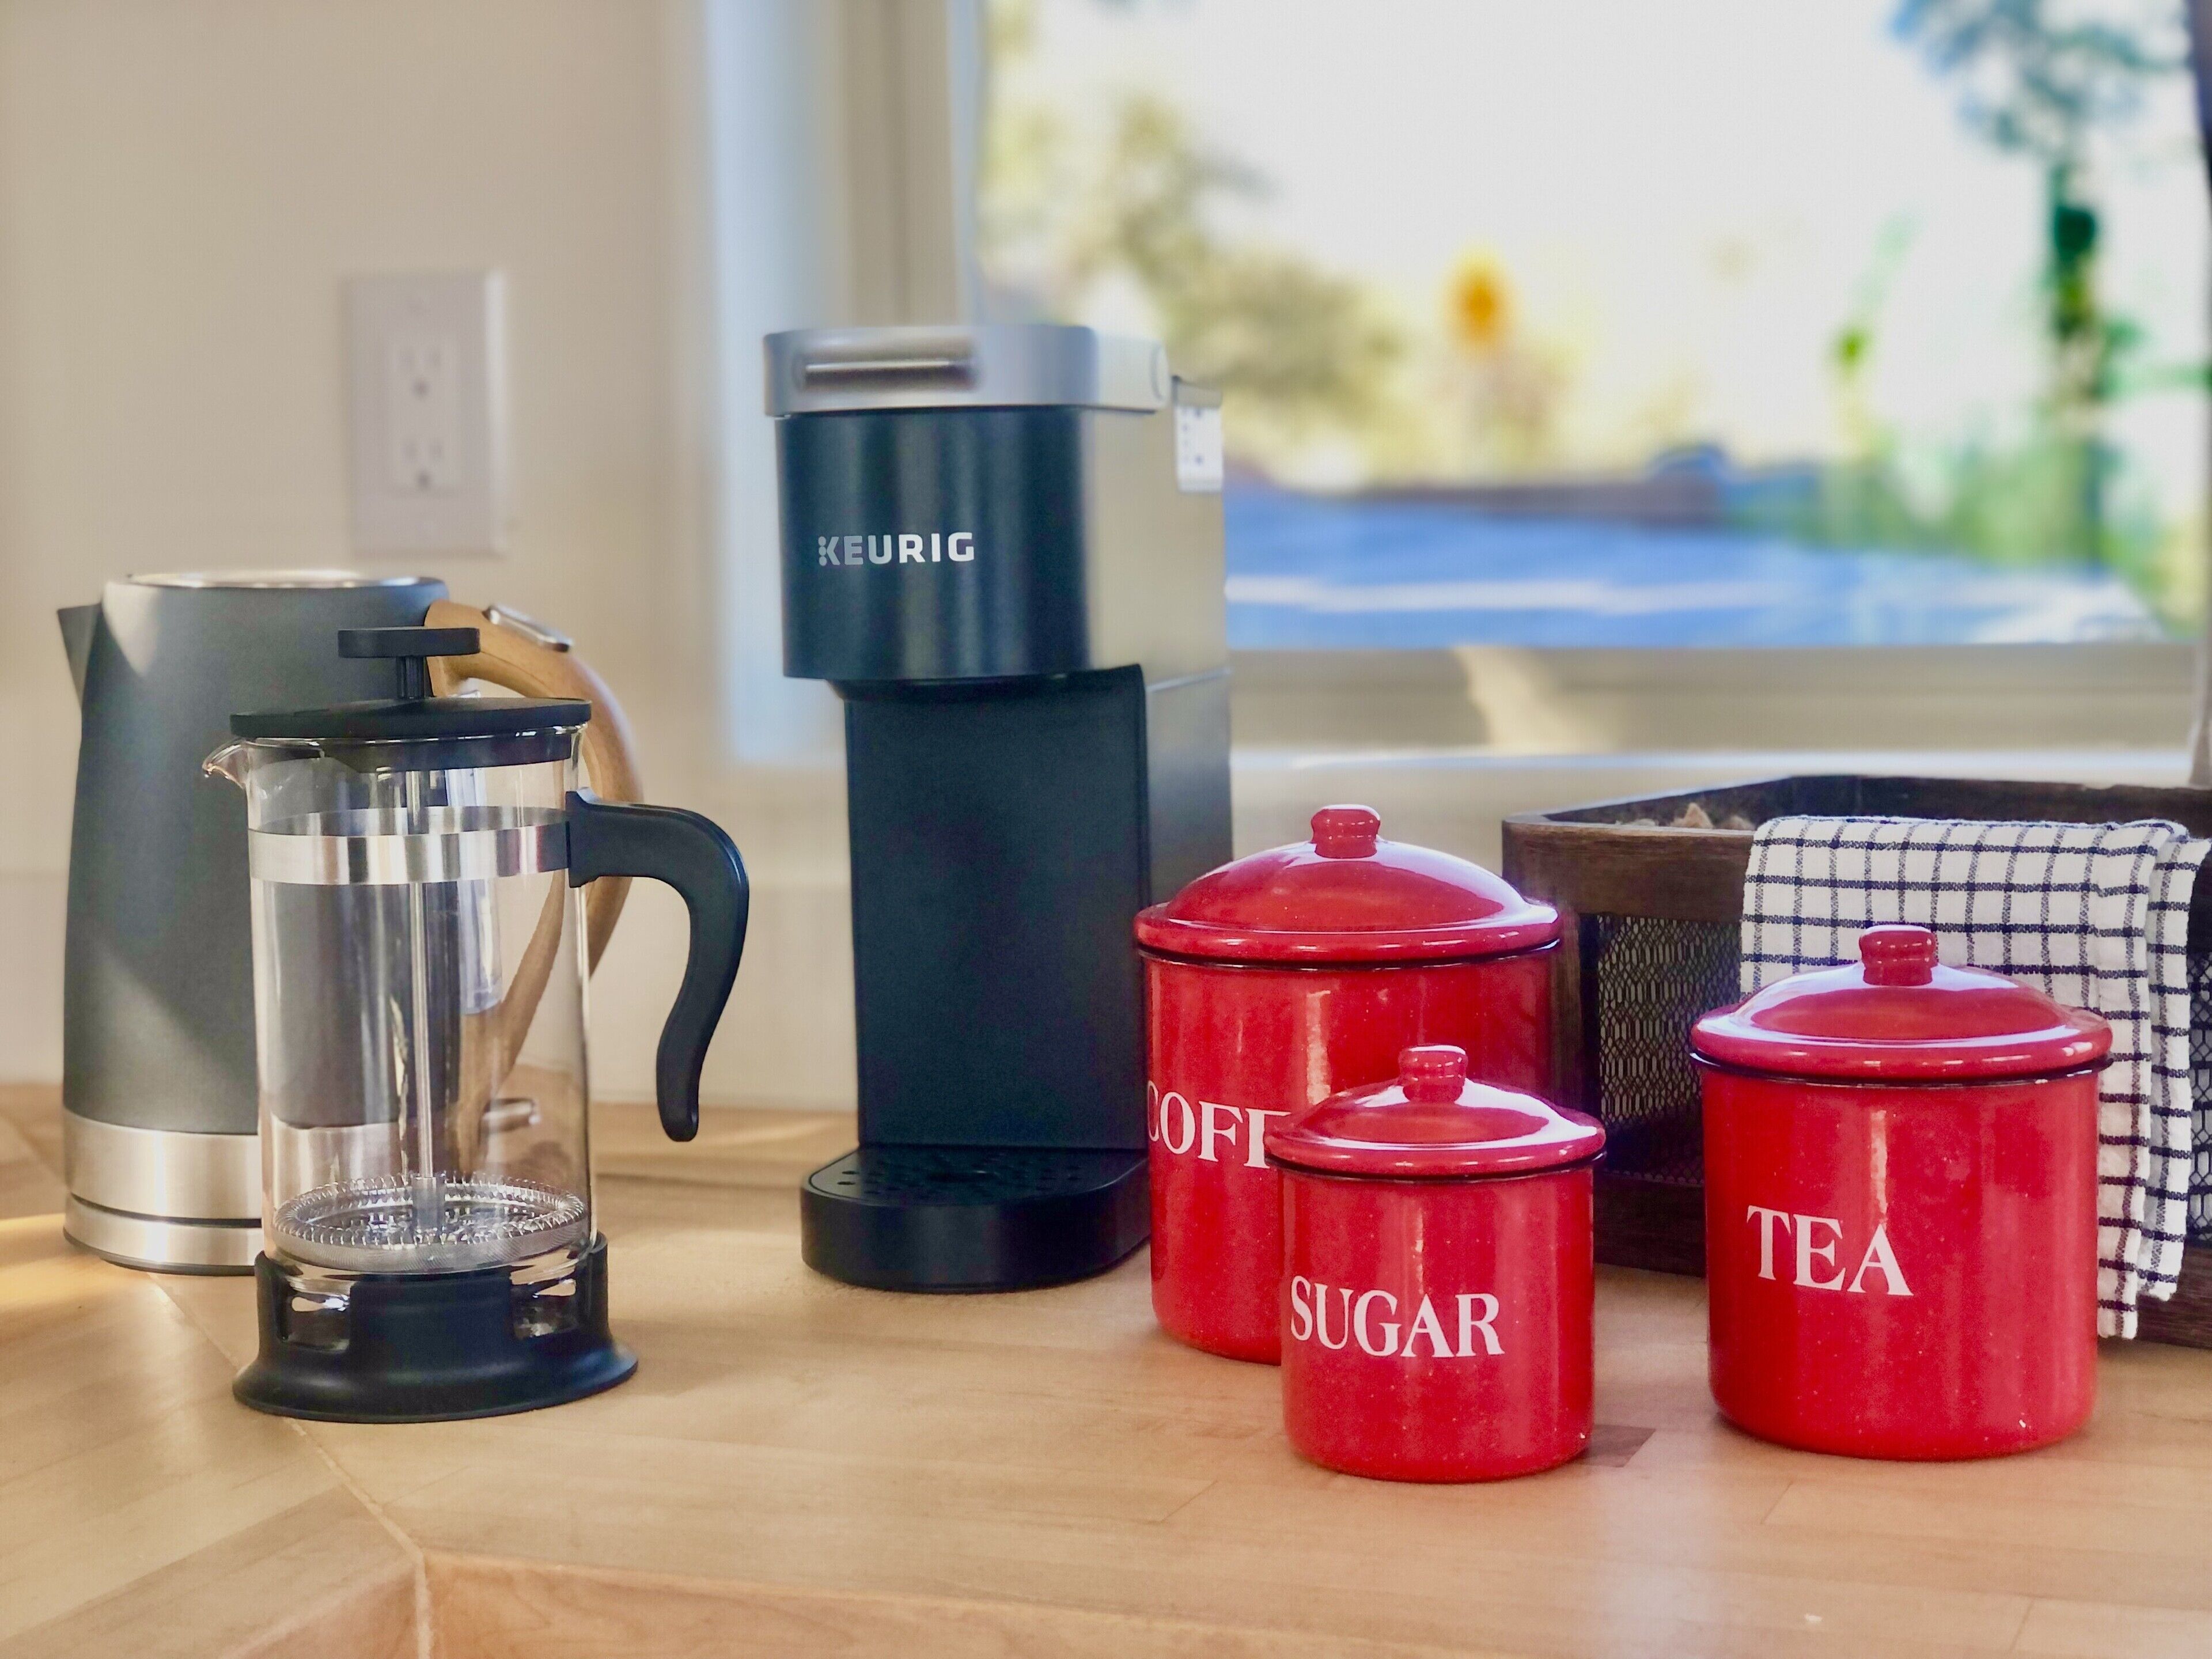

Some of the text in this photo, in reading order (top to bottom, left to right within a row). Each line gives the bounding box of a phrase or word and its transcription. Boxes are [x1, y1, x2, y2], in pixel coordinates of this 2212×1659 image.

[818, 532, 975, 566] KEURIG
[1747, 1205, 1914, 1296] TEA
[1291, 1275, 1505, 1357] SUGAR
